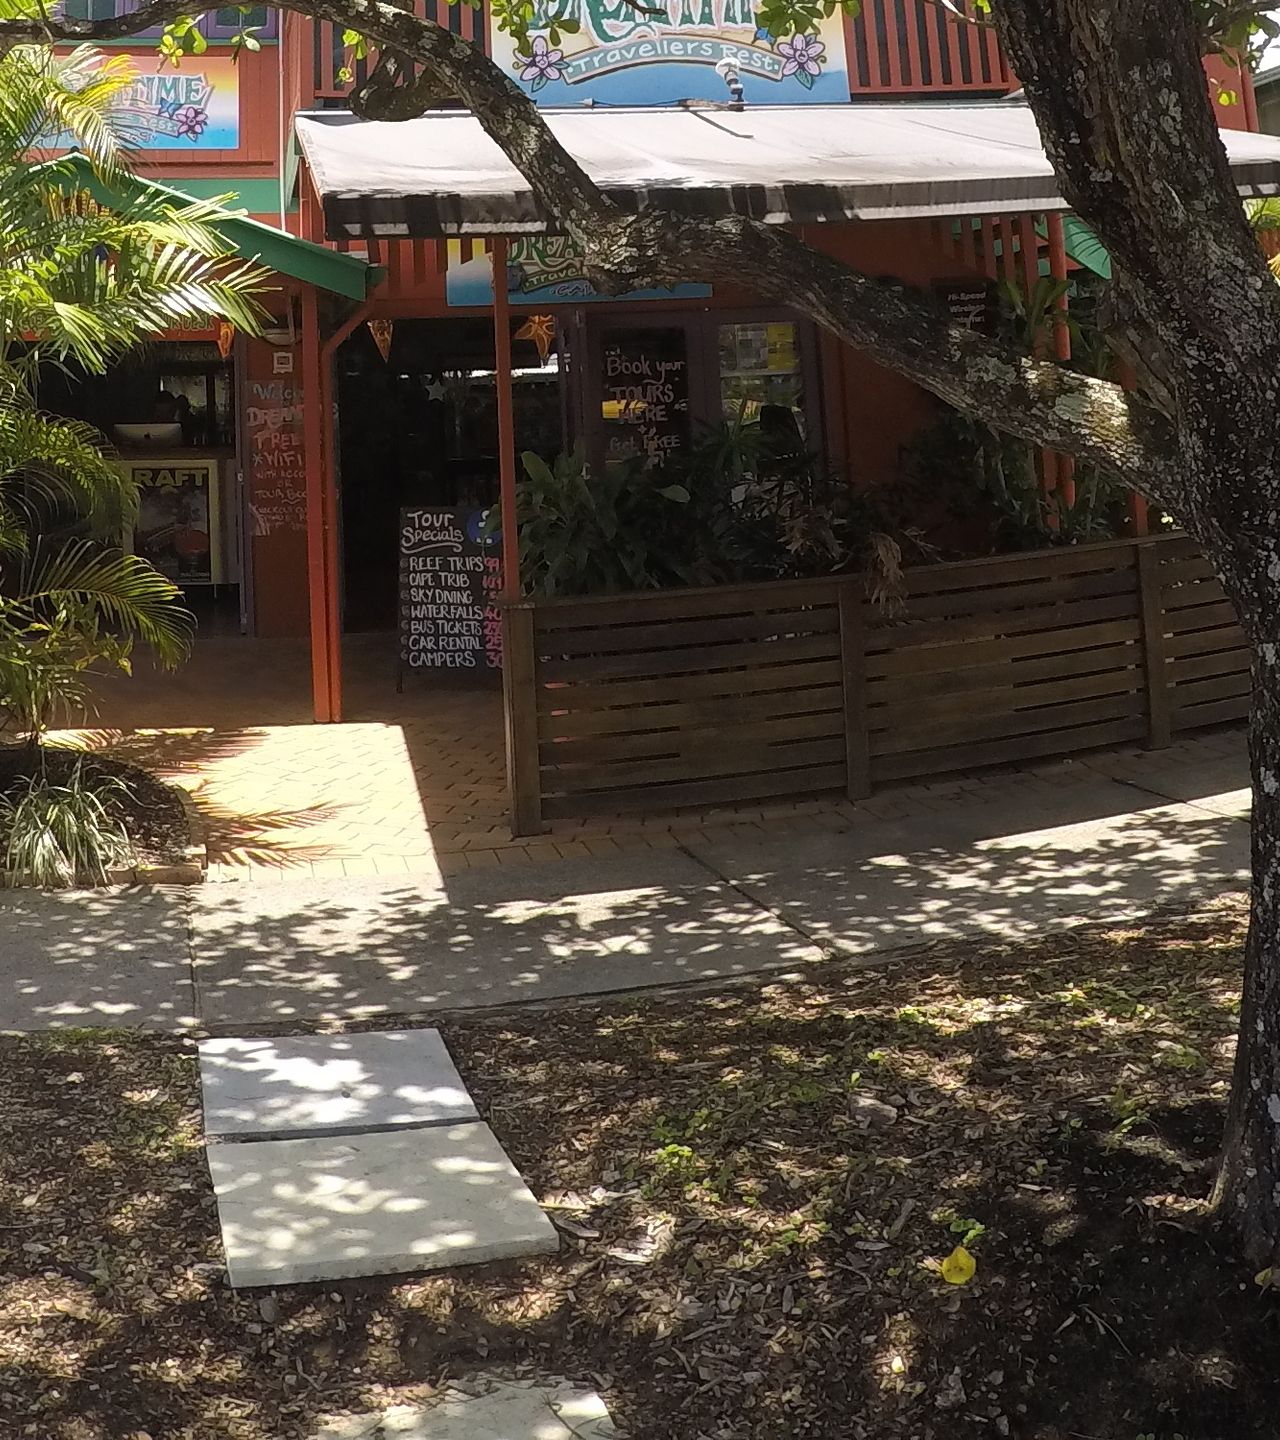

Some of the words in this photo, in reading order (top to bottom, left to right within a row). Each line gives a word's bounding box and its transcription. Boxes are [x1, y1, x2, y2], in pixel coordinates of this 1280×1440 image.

[577, 40, 713, 75] Travellers
[720, 41, 772, 75] Rest
[606, 354, 652, 376] Book
[644, 361, 686, 385] your
[609, 384, 675, 403] TOURS
[133, 469, 208, 487] RAFT
[407, 510, 455, 529] Tour
[401, 526, 465, 547] Specials
[409, 556, 444, 572] REEF
[447, 556, 484, 573] TRIPS
[409, 572, 436, 586] CAPE
[438, 571, 470, 587] TRIB
[410, 604, 484, 621] WATERFALLS
[410, 620, 435, 634] BUS
[436, 619, 483, 636] TICKETS
[408, 635, 438, 650] CAR
[439, 635, 485, 651] RENTAL
[408, 650, 476, 668] CAMPERS
